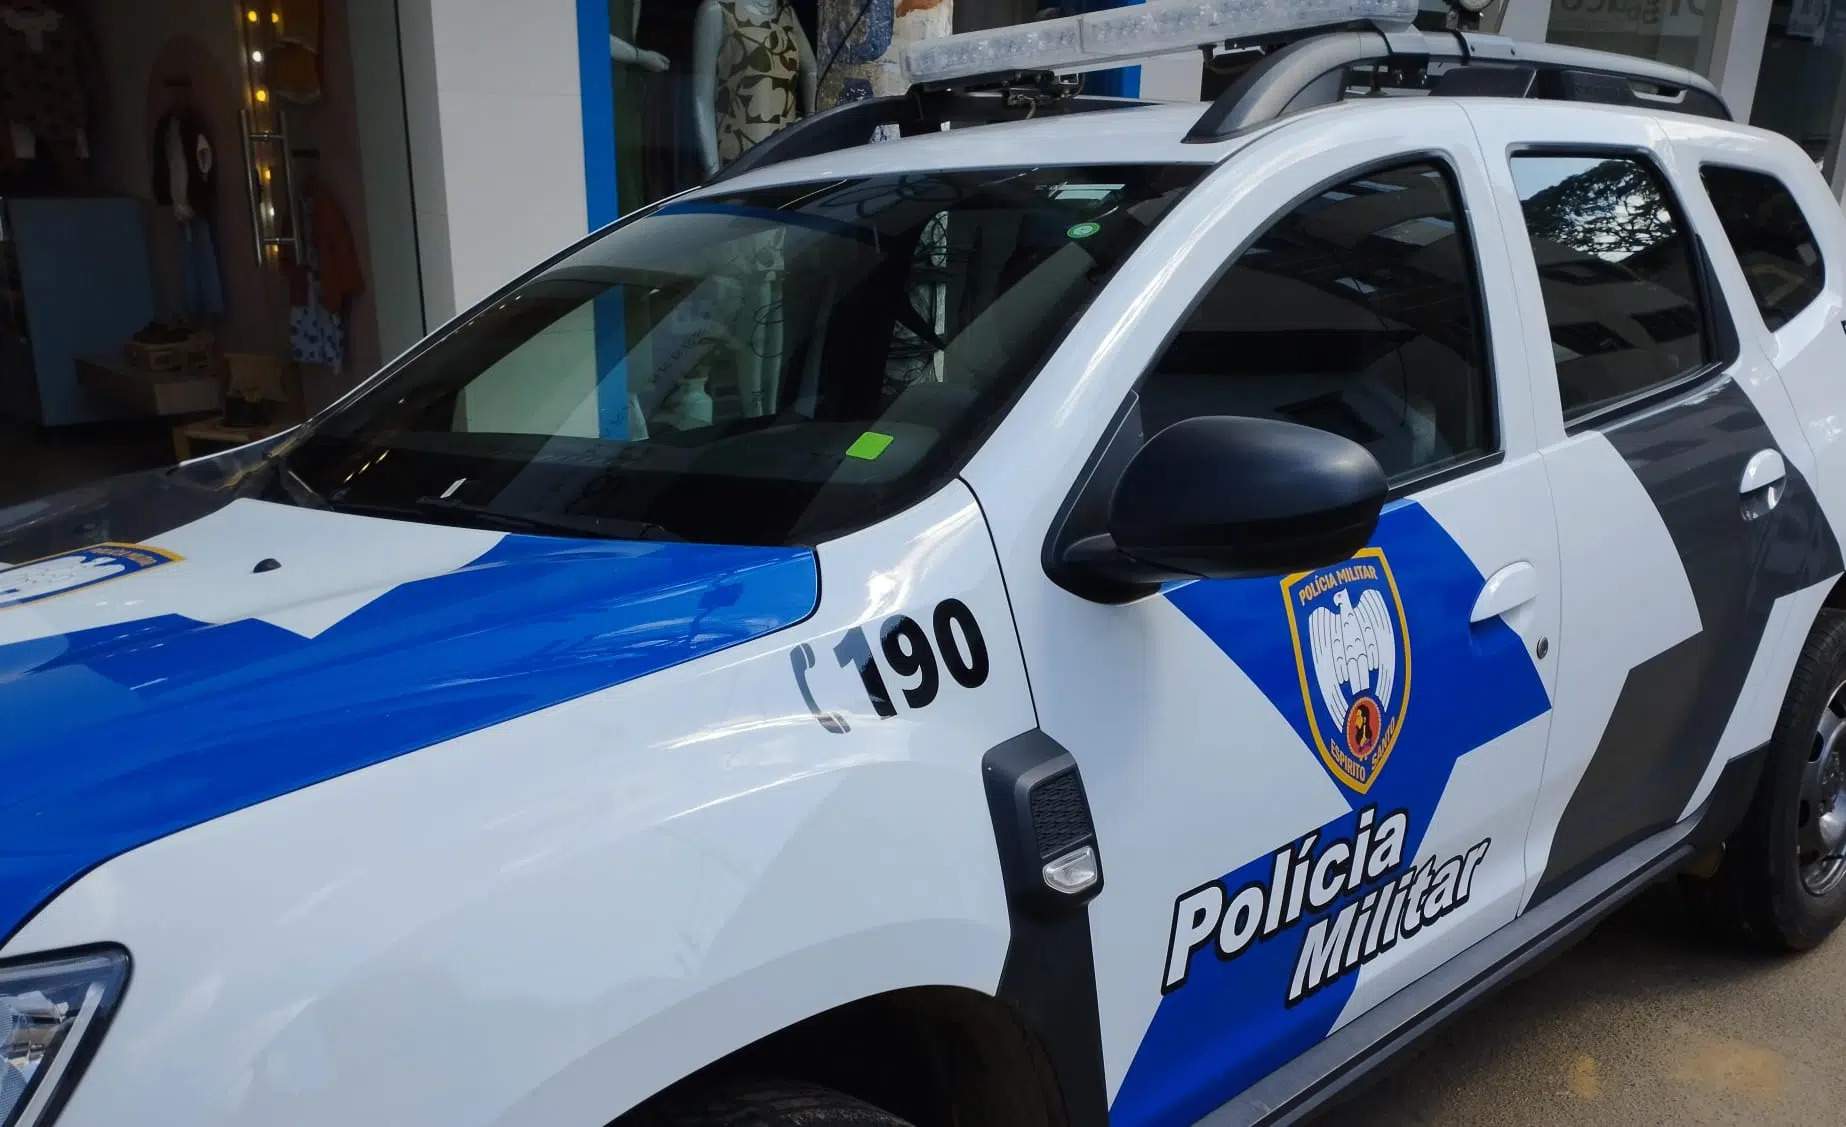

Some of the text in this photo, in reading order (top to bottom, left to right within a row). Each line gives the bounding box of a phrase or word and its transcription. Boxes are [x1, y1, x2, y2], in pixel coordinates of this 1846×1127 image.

[1298, 565, 1378, 606] POLÍCIA MILITAR
[833, 598, 990, 720] 190
[1371, 716, 1396, 769] SANTO
[1161, 804, 1410, 996] Polícia
[1285, 837, 1493, 1009] Militar
